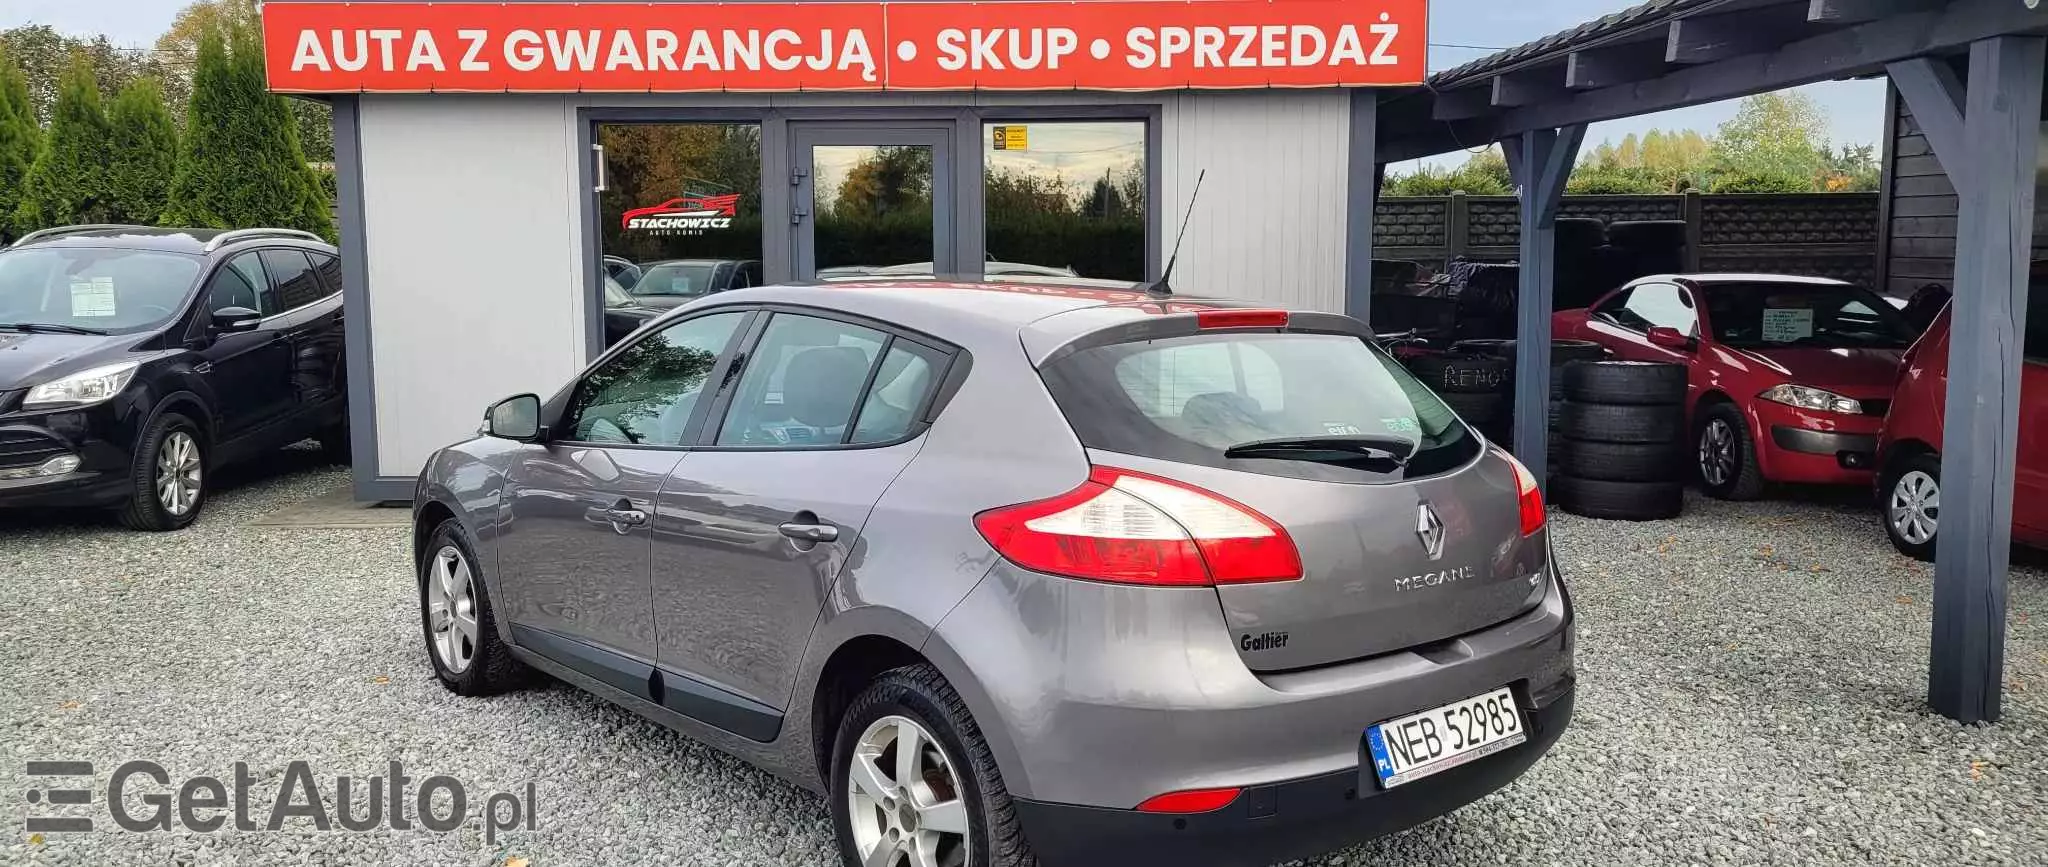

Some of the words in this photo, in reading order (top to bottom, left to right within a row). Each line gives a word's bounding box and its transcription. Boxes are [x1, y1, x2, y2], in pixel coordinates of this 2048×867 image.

[291, 29, 445, 72] AUTA
[456, 29, 490, 72] Z
[503, 28, 877, 82] GWARANCJĄ
[937, 27, 1078, 70] SKUP
[1126, 11, 1399, 69] SPRZEDAŻ
[627, 217, 732, 229] STACHOWICZ
[1394, 566, 1475, 592] MEGANE
[1240, 631, 1289, 651] Galtier
[1385, 717, 1443, 770] NEB
[1443, 693, 1517, 750] 52985
[1379, 760, 1391, 772] PL
